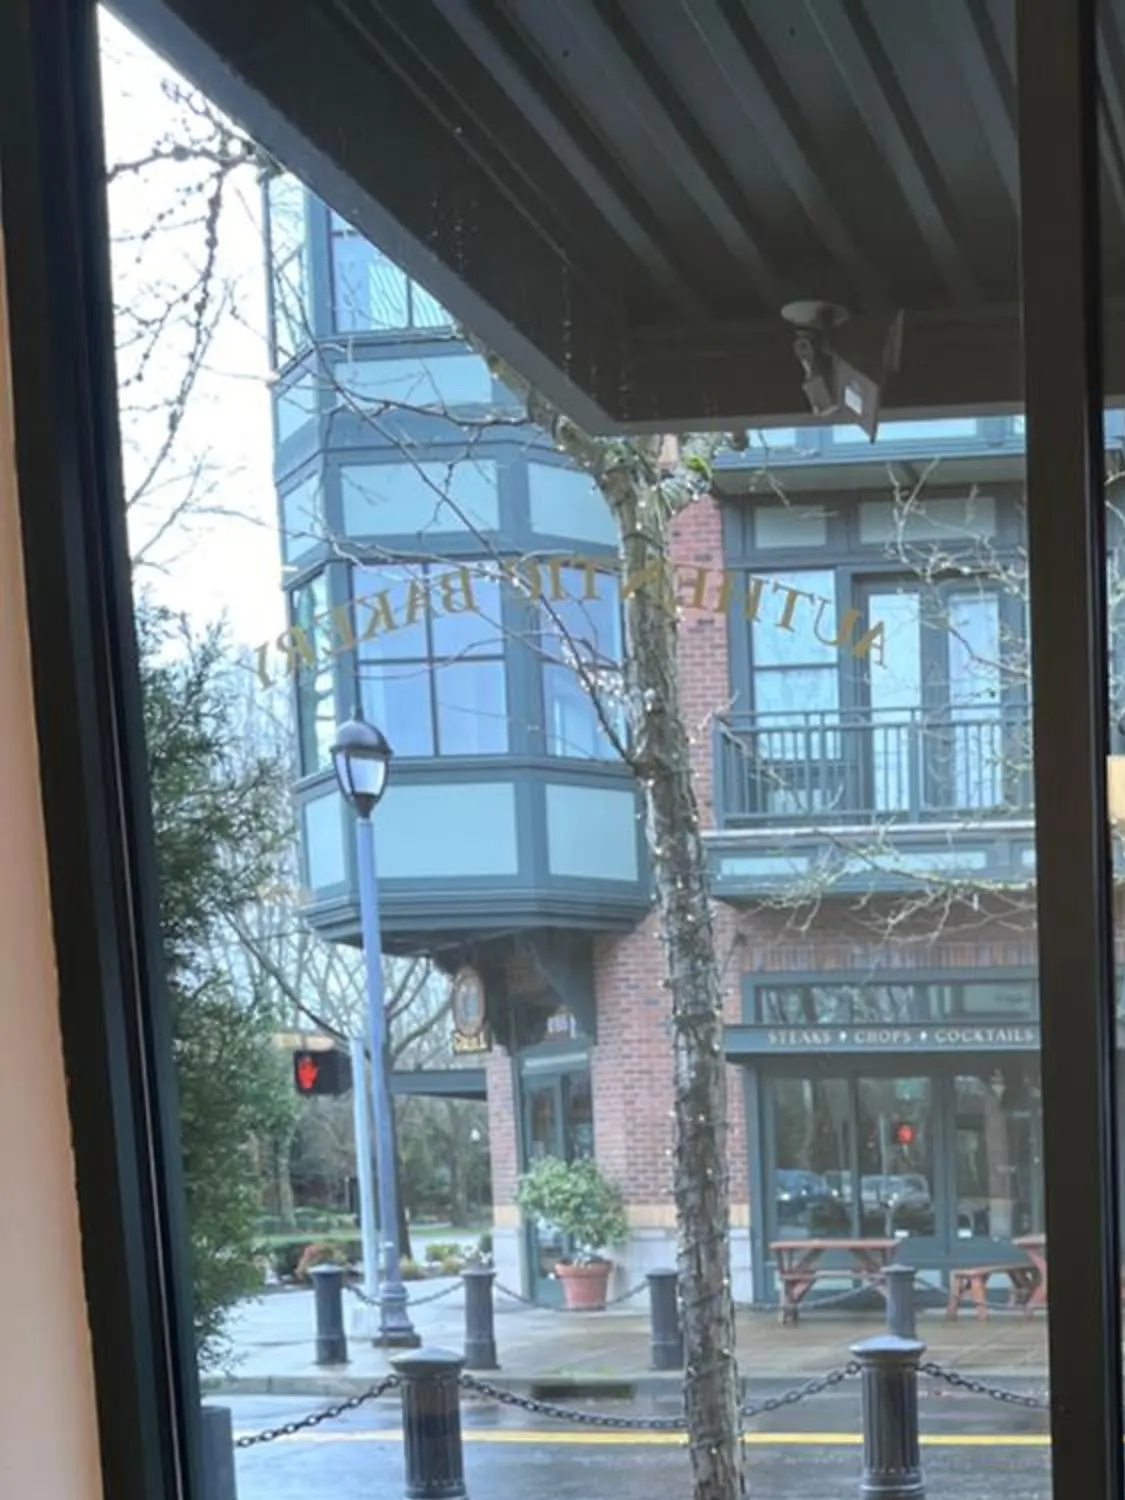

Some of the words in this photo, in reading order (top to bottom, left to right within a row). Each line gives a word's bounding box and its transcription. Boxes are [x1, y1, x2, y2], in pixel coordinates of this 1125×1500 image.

[768, 1029, 833, 1045] STEAKS
[853, 1028, 912, 1044] CHOPS
[934, 1027, 1035, 1044] COCKTAILS
